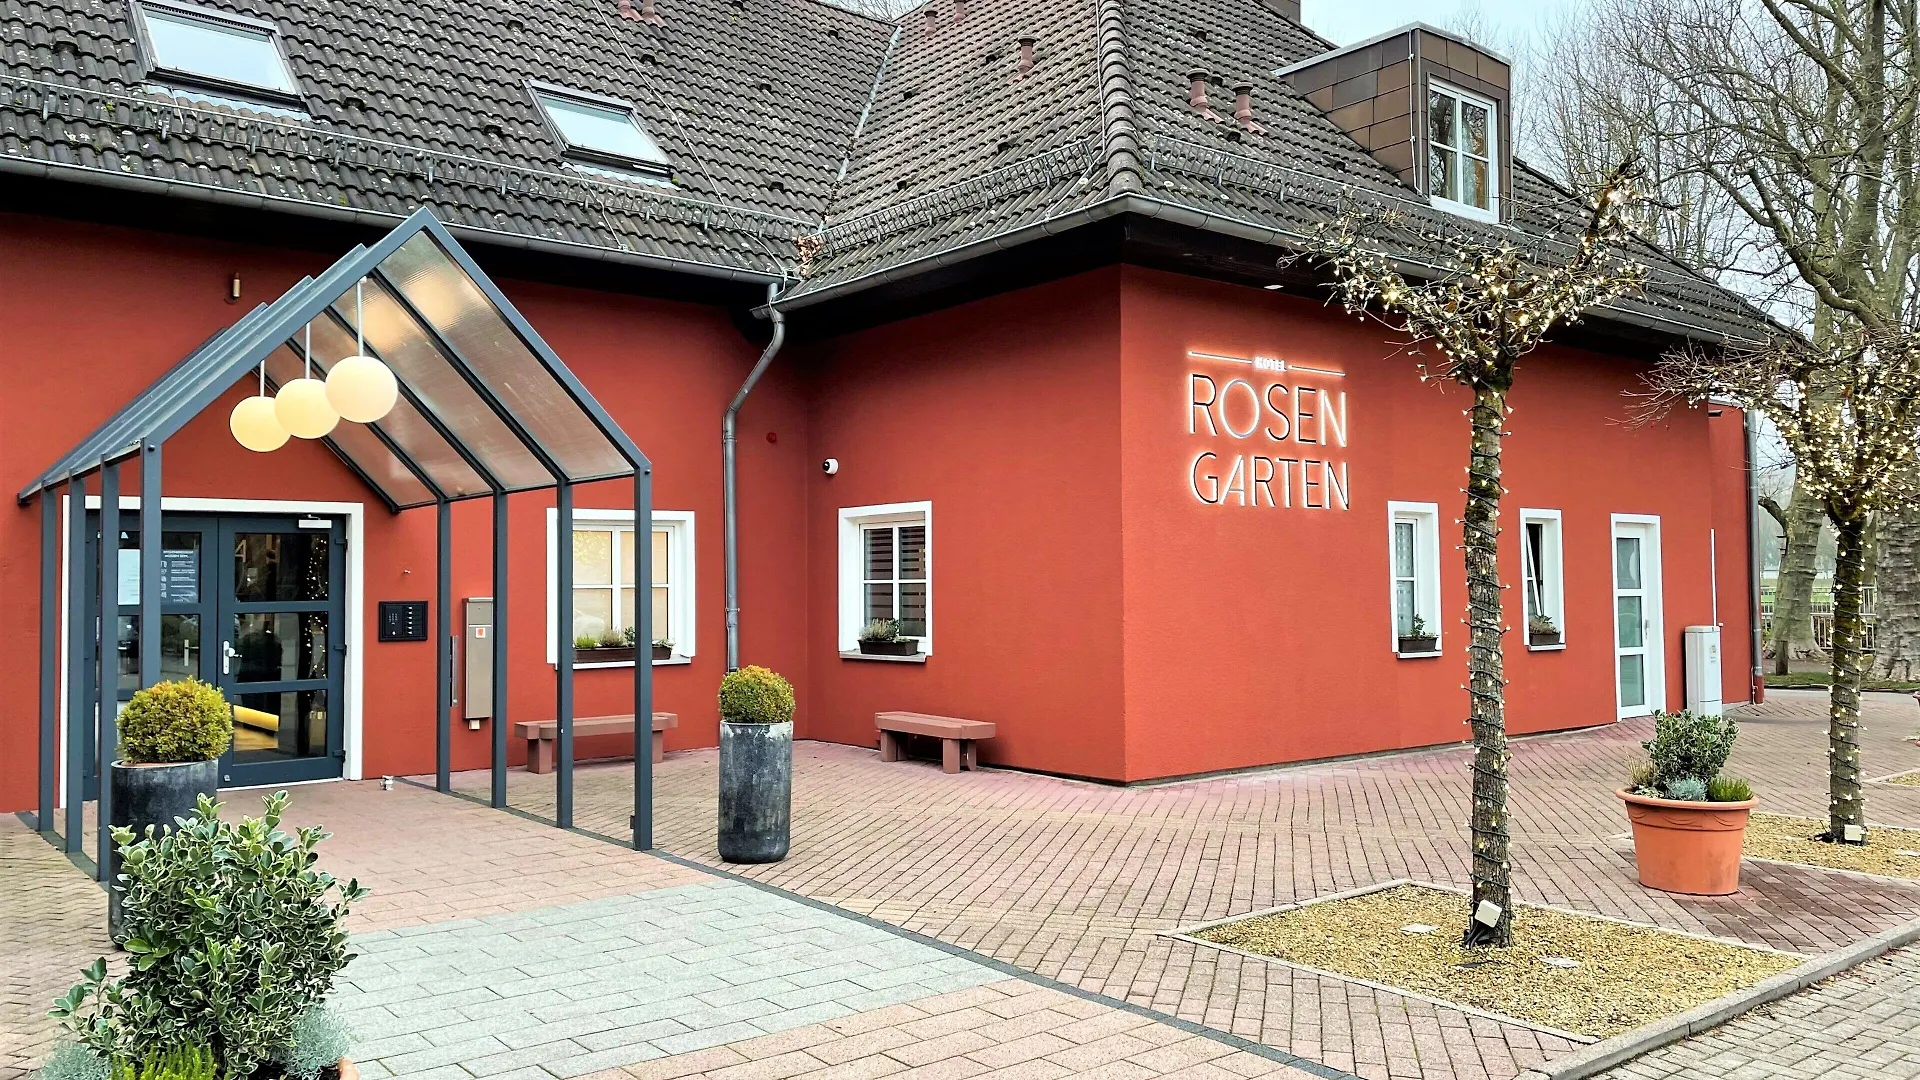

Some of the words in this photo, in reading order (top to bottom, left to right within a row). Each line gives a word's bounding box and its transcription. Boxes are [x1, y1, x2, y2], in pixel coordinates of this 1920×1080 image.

[1255, 356, 1287, 372] HOTEL
[1189, 373, 1347, 447] ROSEN
[1189, 451, 1349, 511] GARTEN
